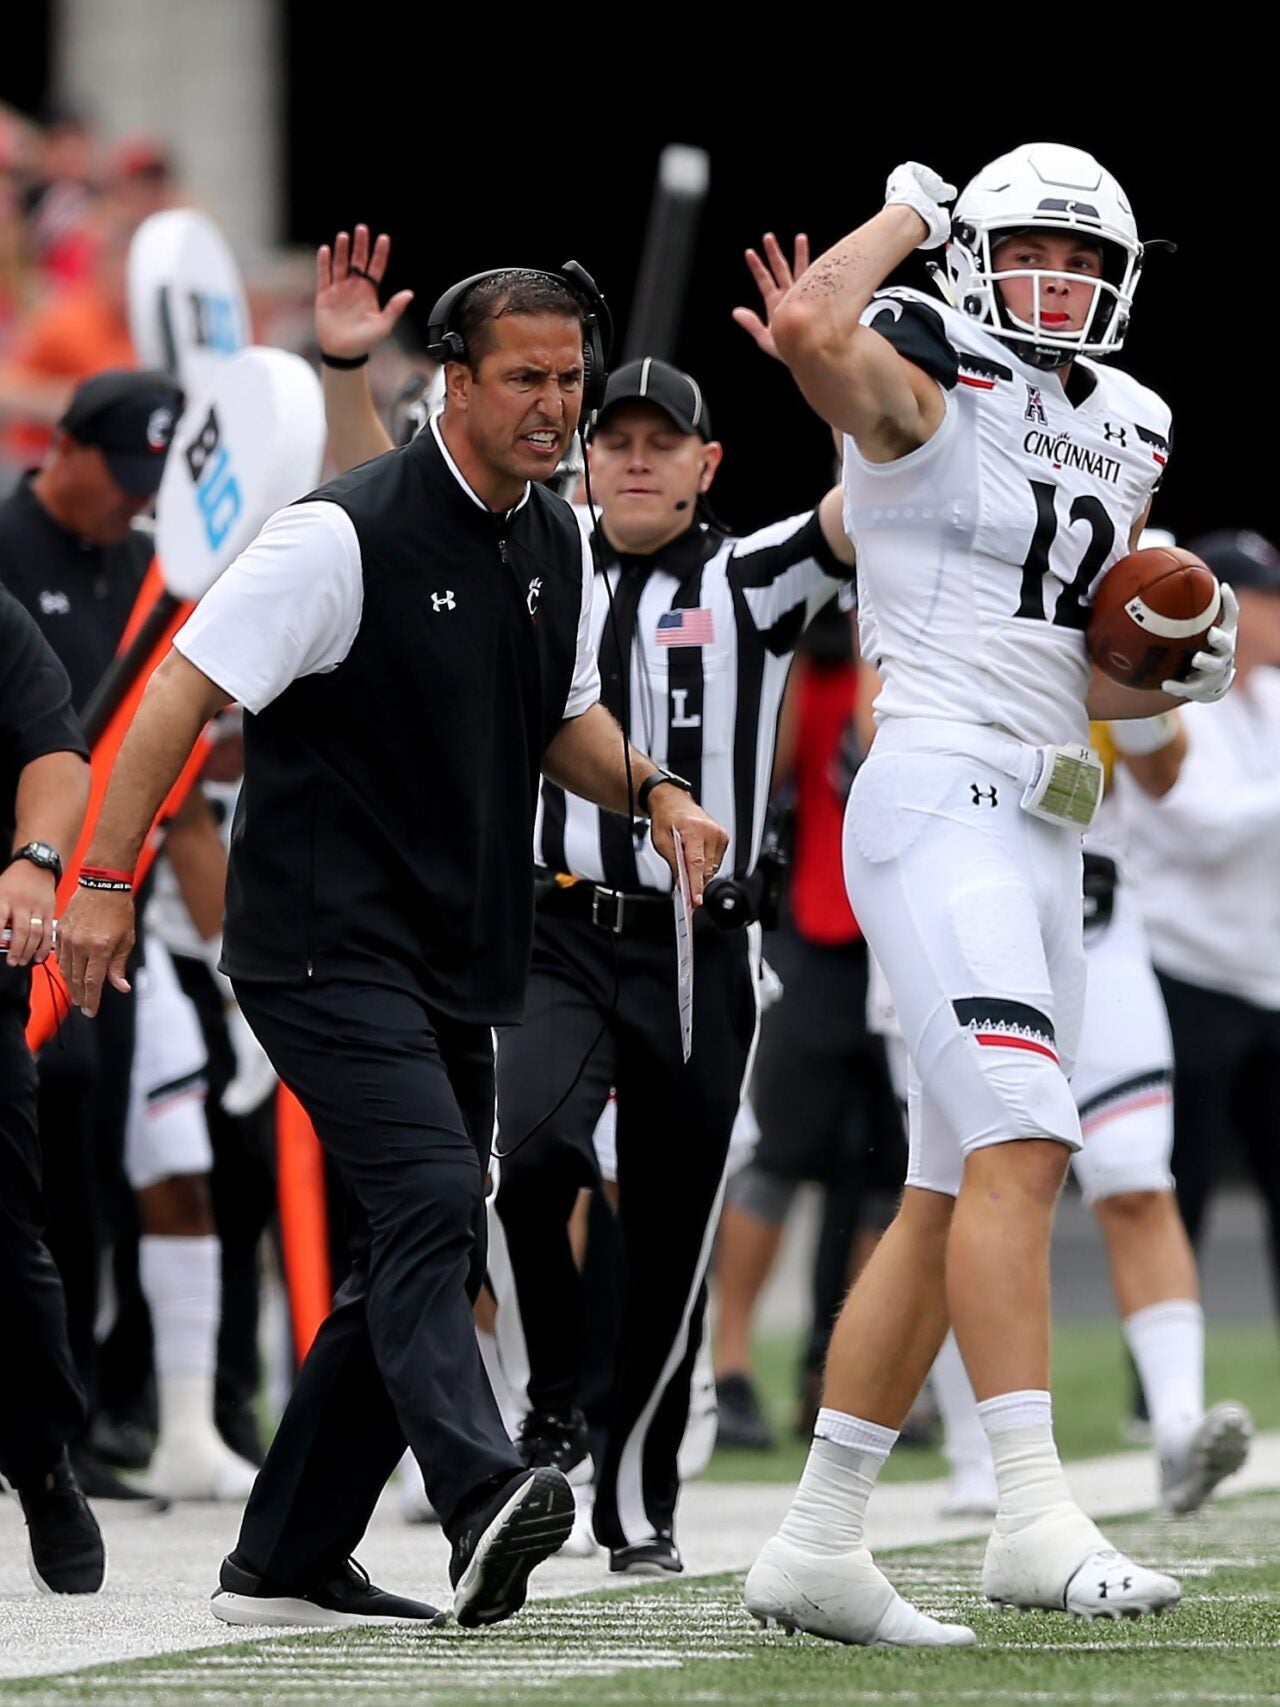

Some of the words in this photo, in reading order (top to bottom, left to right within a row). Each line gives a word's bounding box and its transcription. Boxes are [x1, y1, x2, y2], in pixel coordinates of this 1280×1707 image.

[1023, 430, 1122, 484] CINCINNATI
[1012, 478, 1116, 631] 12
[671, 688, 701, 728] L
